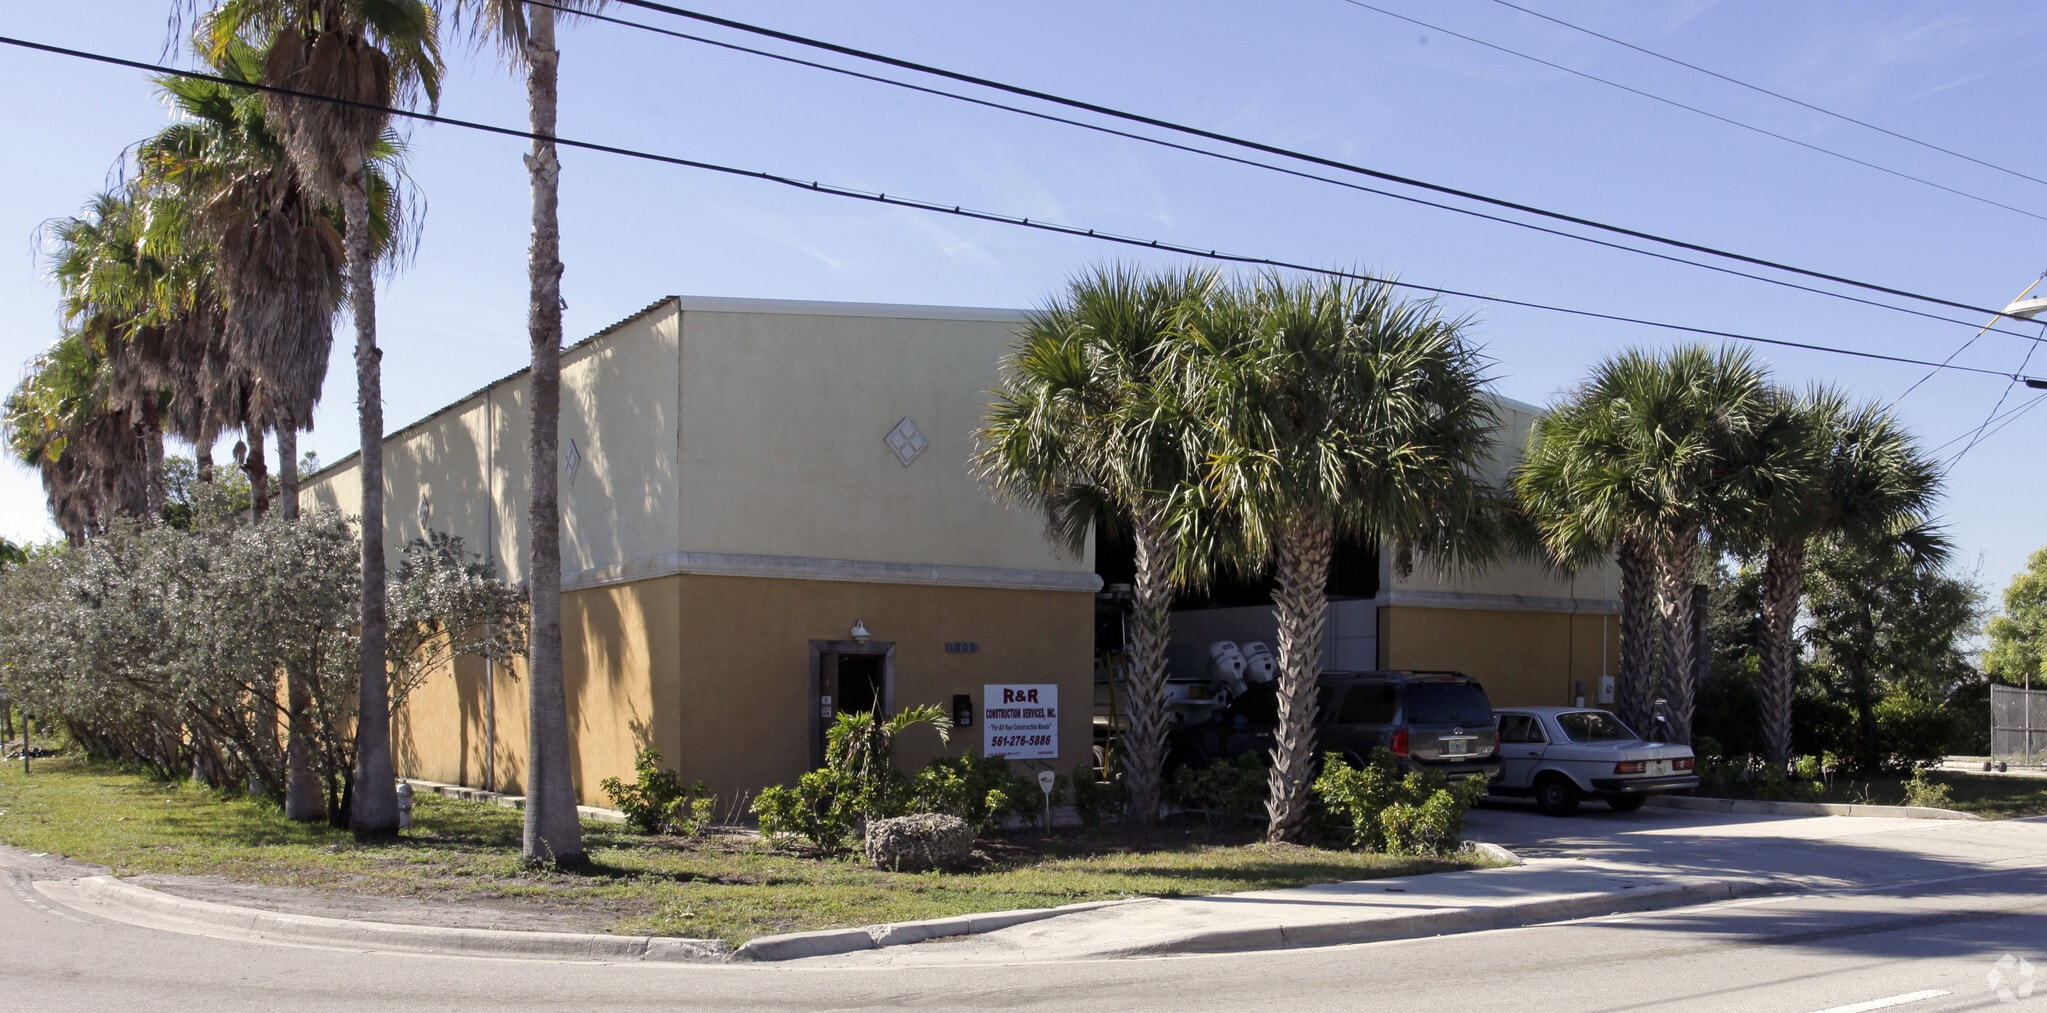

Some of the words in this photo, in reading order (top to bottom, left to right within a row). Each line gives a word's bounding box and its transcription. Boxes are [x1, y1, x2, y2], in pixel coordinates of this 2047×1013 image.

[1003, 688, 1039, 704] R&R
[986, 708, 1021, 719] CONSTRUCTION
[1022, 708, 1046, 719] SERVICES,
[1047, 708, 1056, 718] INC.
[1005, 723, 1013, 731] Your
[1013, 723, 1038, 731] Construction
[991, 735, 1051, 747] 561-276-5886
